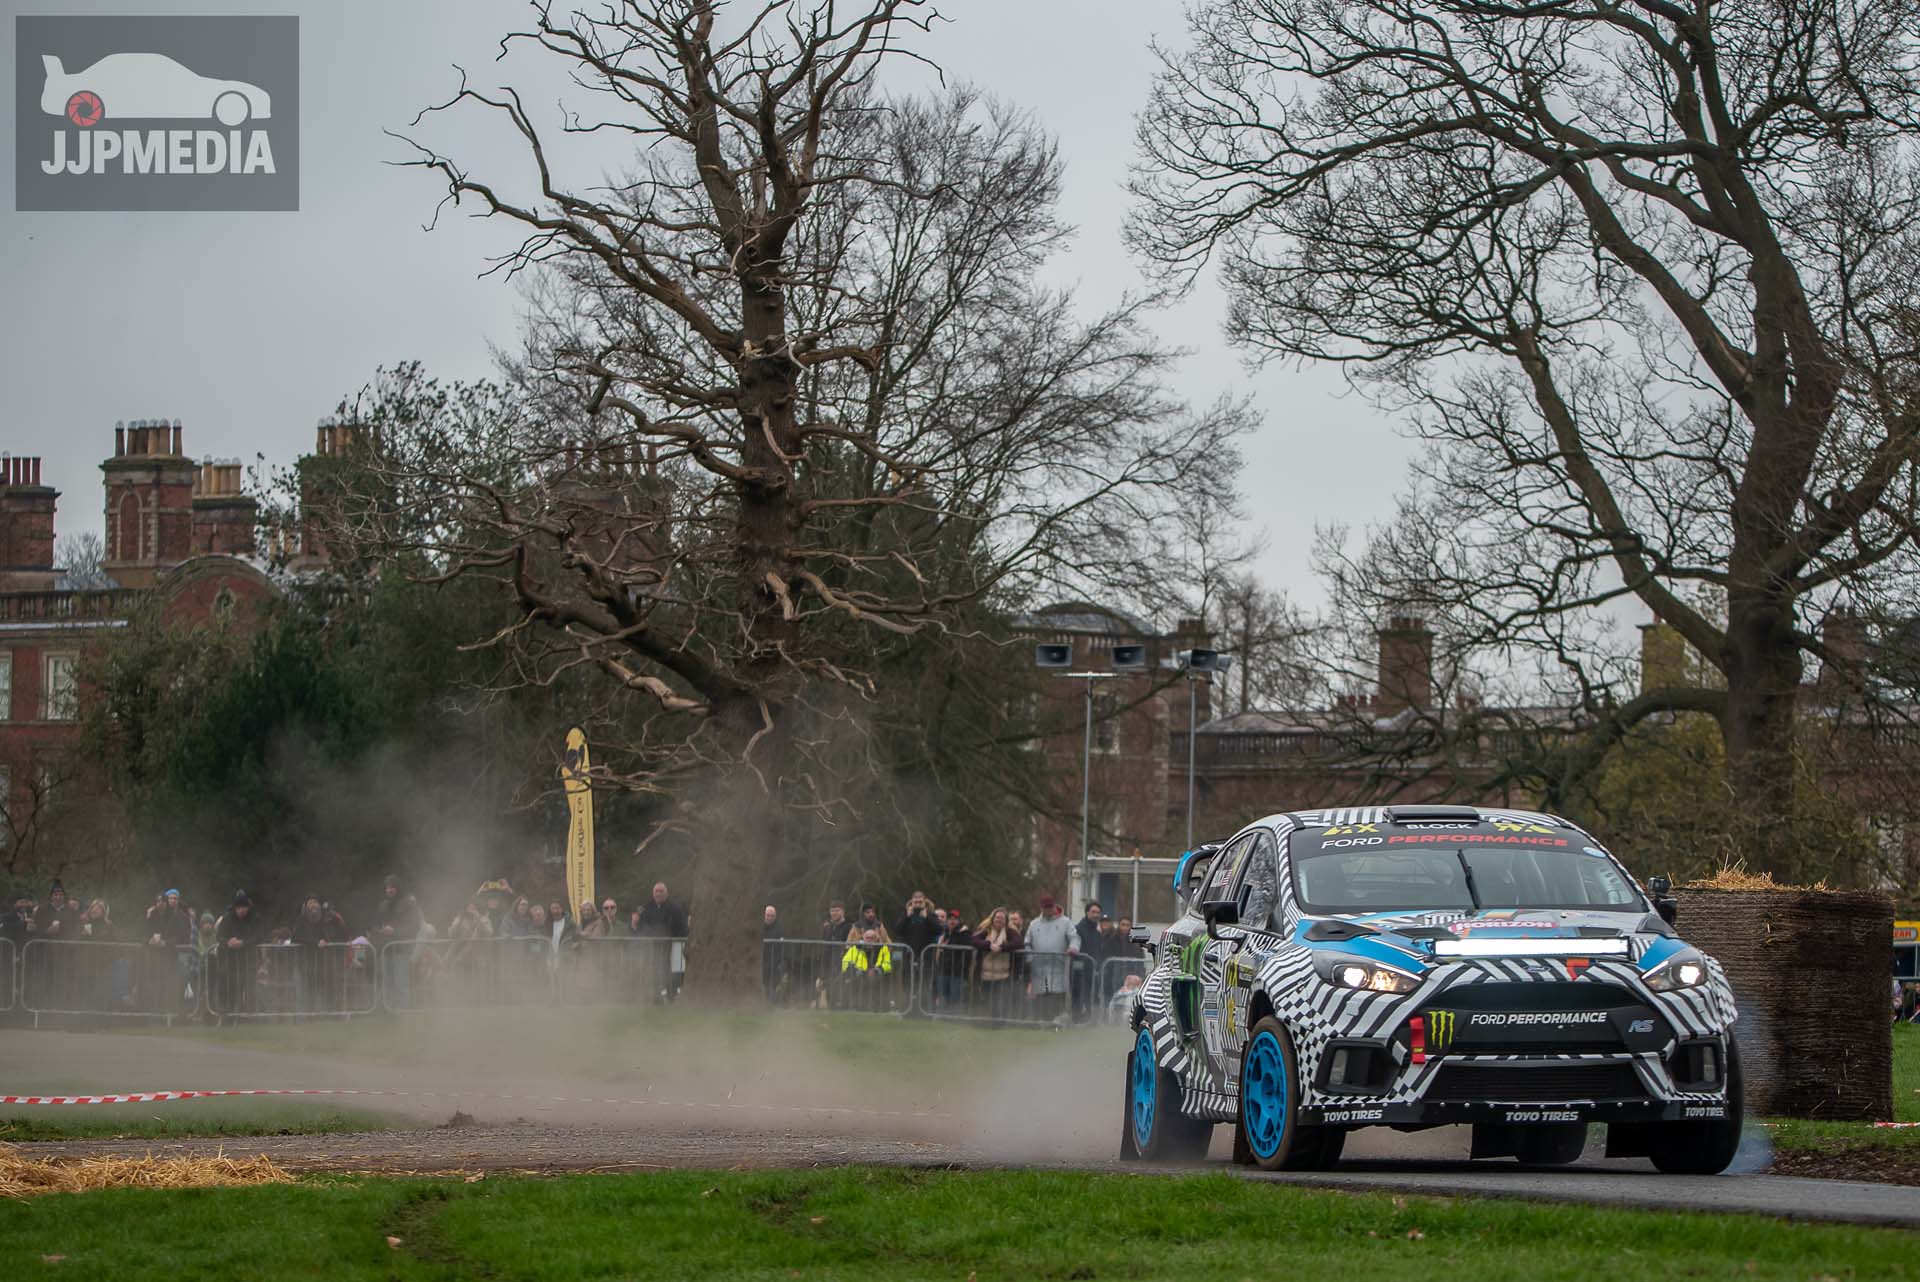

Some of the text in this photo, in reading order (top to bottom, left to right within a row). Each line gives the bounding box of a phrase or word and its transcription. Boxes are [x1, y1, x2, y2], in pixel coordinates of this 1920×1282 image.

[1321, 834, 1568, 849] FORD PERFORMANCE
[1455, 921, 1552, 930] HORIZON
[1470, 1012, 1607, 1025] FORD PERFORMANCE
[1628, 1019, 1655, 1033] RS
[1323, 1109, 1383, 1122] TOYO TIRES
[1505, 1111, 1579, 1121] TOYO TIRES
[1685, 1106, 1705, 1117] TOYO
